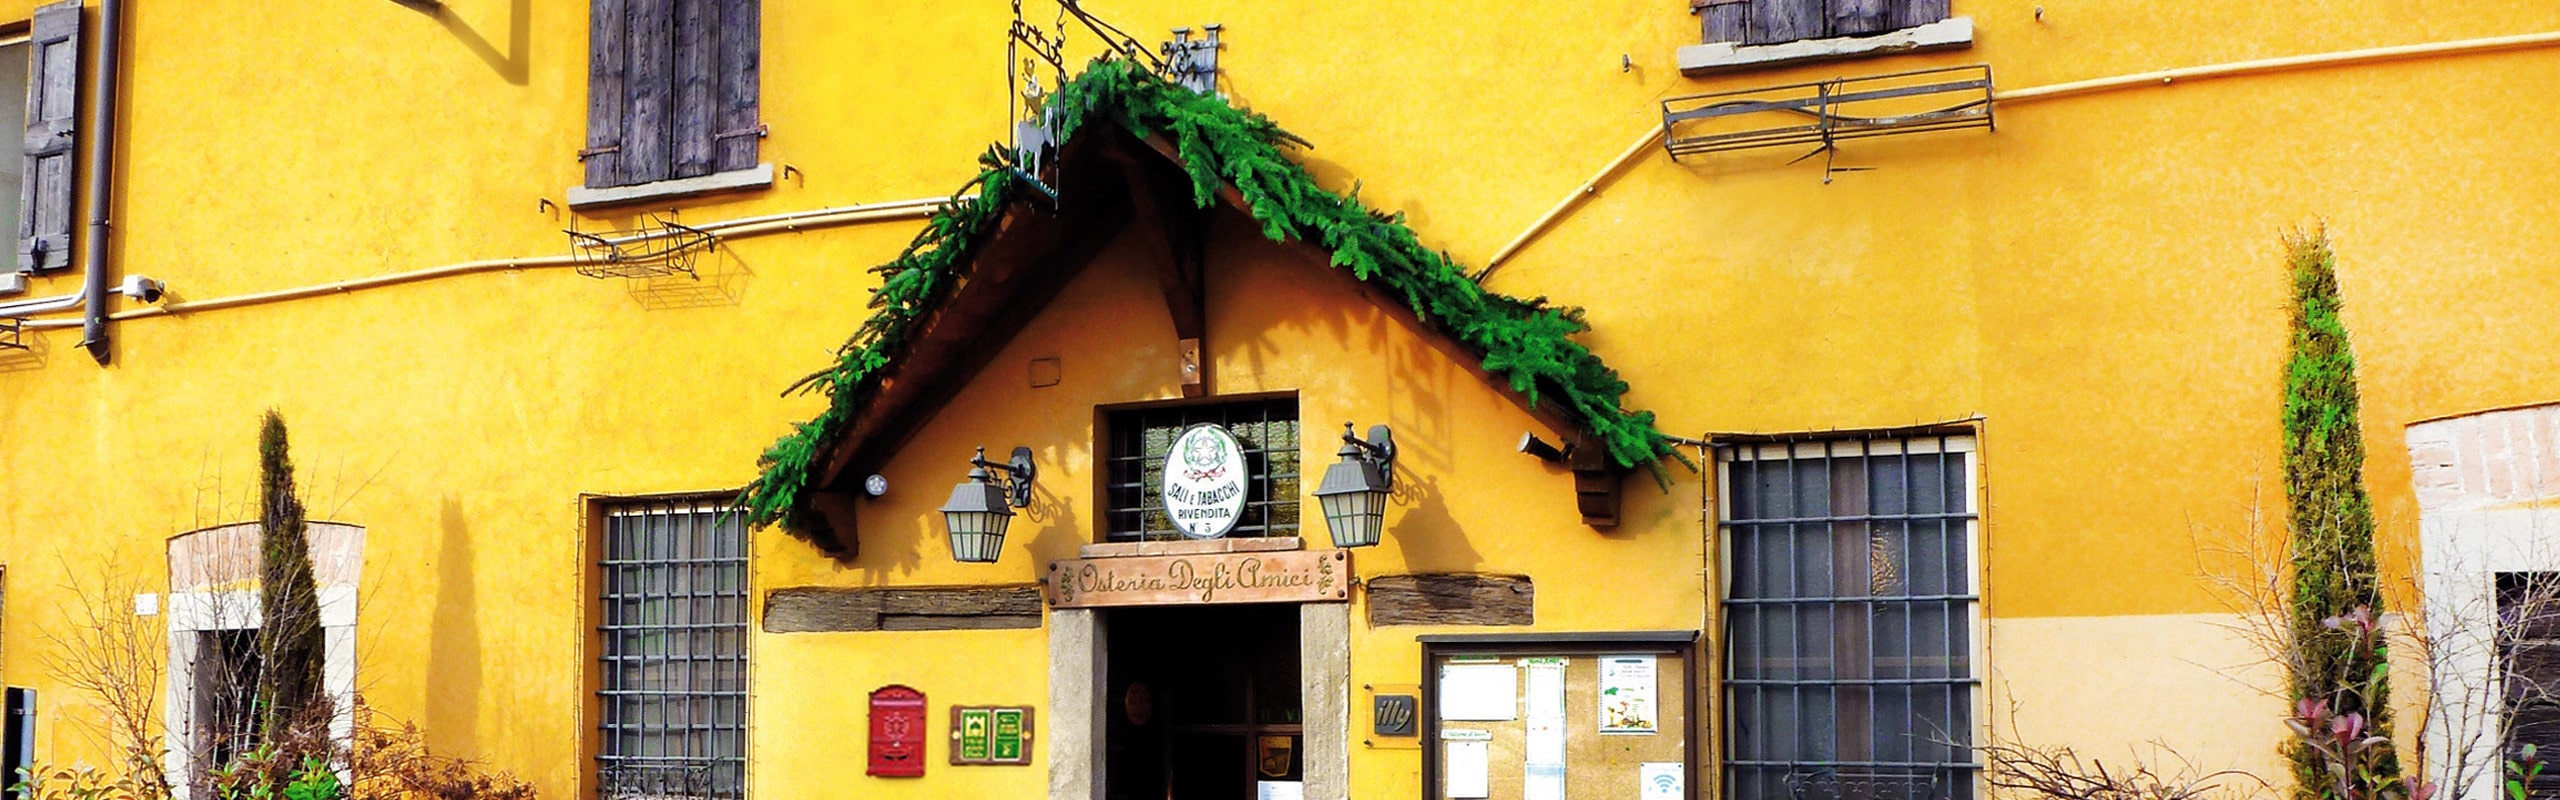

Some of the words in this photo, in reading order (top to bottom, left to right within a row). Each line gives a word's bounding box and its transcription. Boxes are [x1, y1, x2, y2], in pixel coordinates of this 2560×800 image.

[1167, 482, 1189, 503] SALI
[1197, 480, 1240, 506] TABACCHI
[1178, 508, 1231, 519] RIVENDITA
[1077, 563, 1166, 594] Osteria
[1168, 558, 1236, 602] Degli
[1236, 557, 1313, 588] Amici
[1376, 700, 1411, 732] illy
